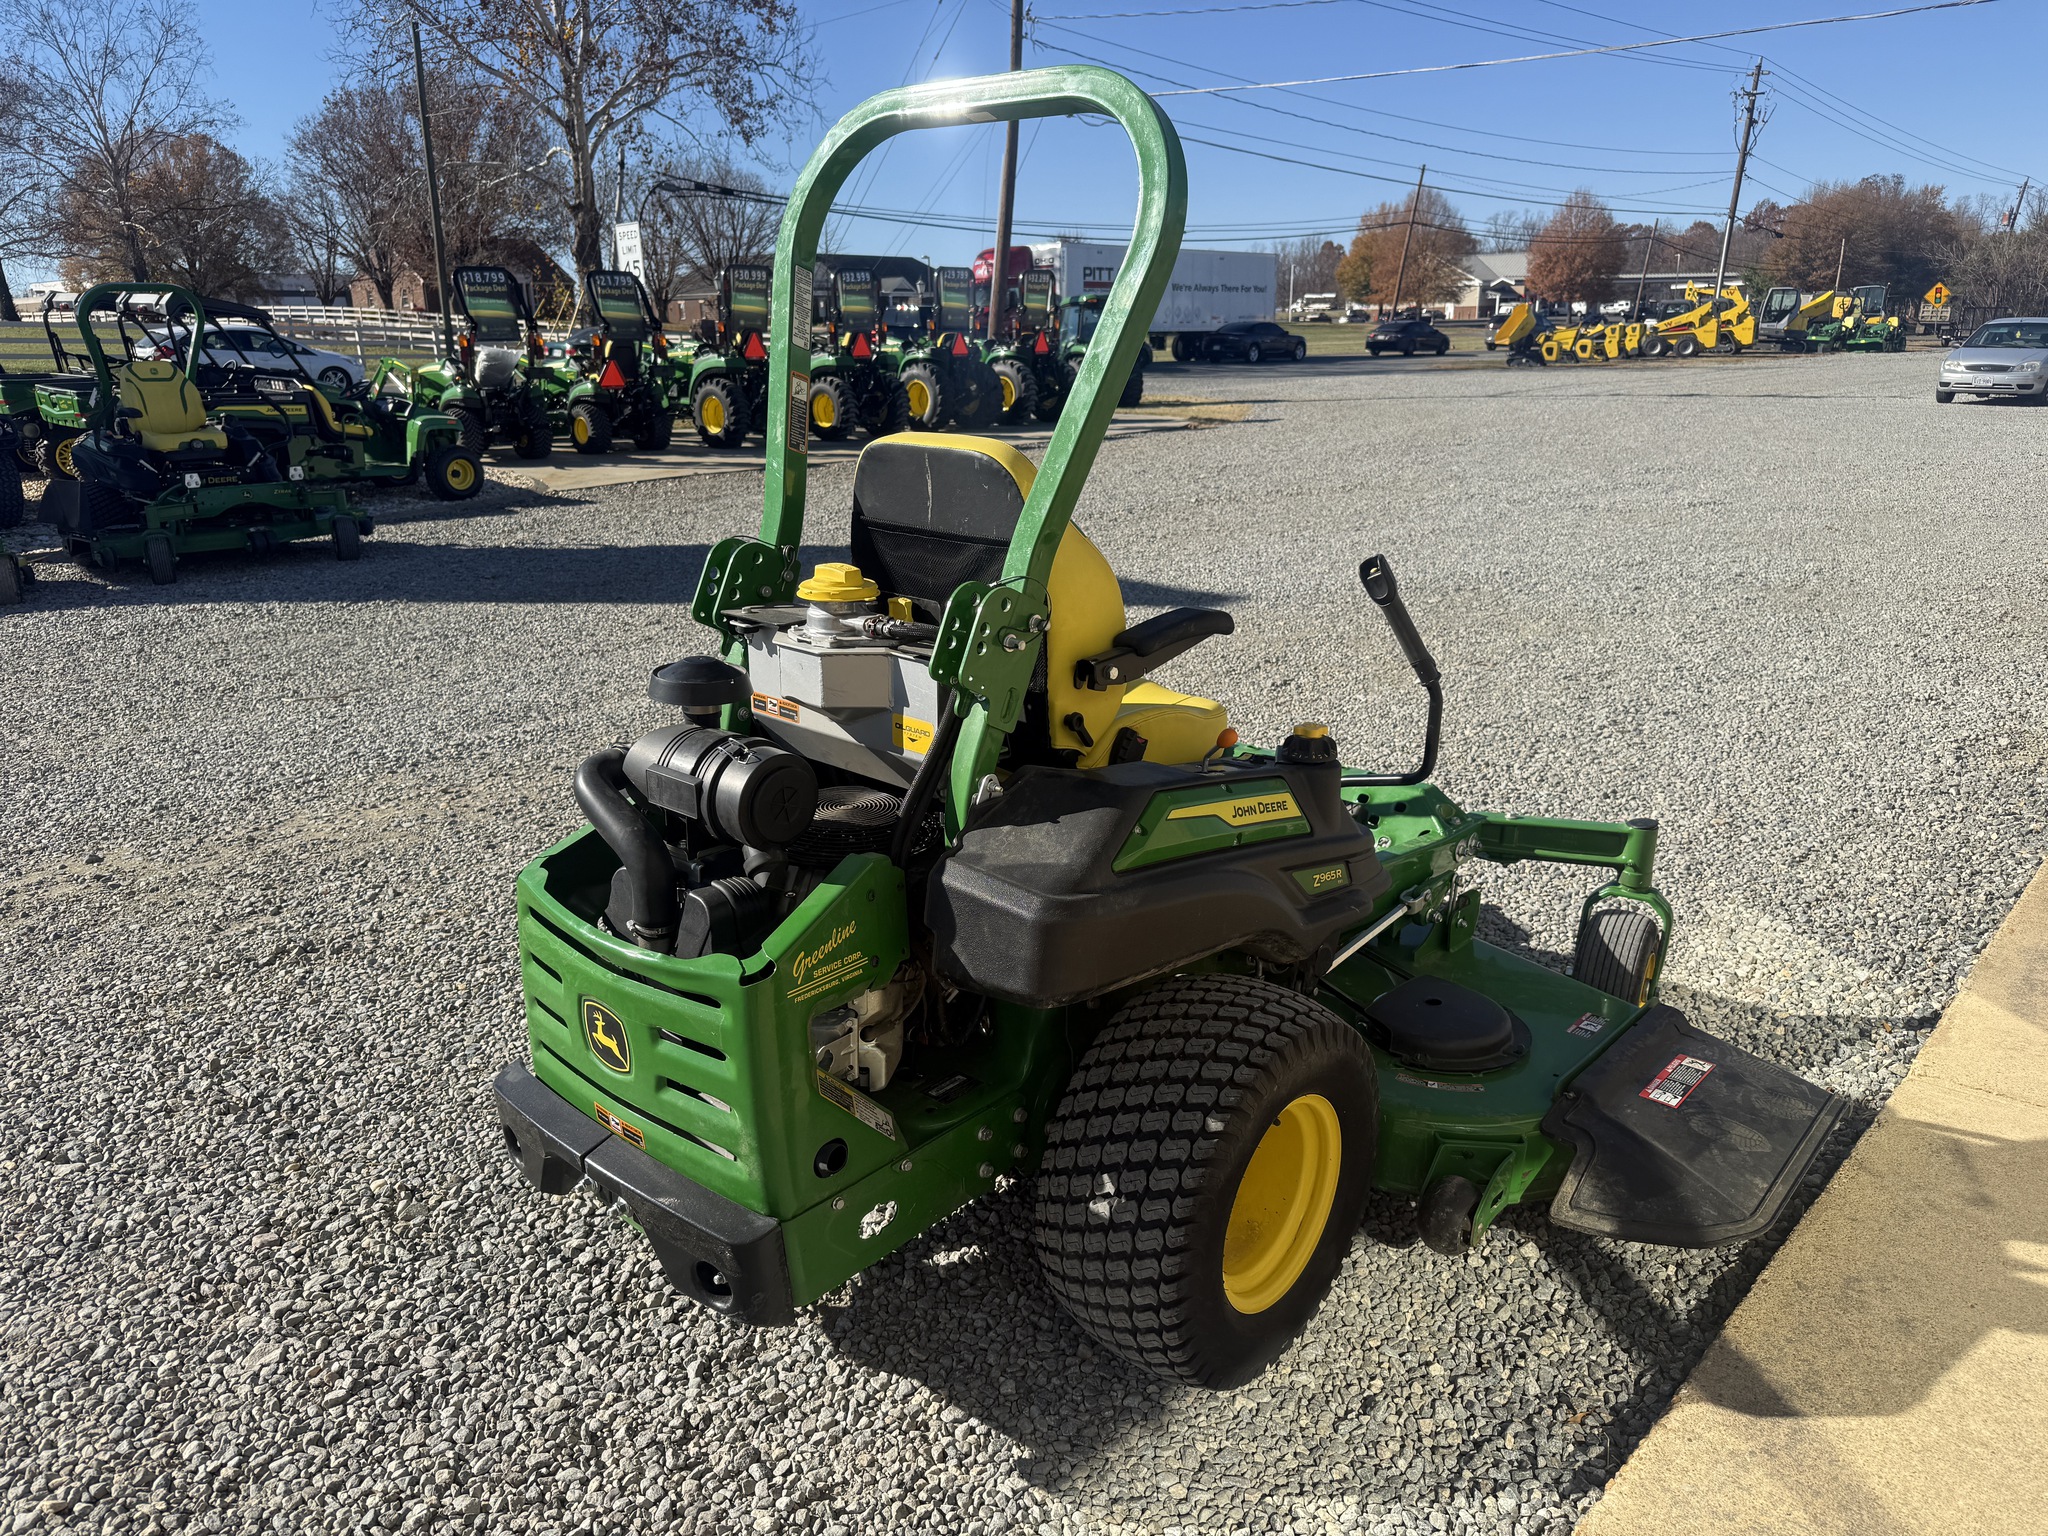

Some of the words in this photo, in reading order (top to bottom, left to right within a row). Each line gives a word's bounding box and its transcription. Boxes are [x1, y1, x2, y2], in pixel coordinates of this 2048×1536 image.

[618, 230, 638, 241] SPEED
[622, 245, 637, 255] LIMIT
[624, 260, 641, 279] 45
[1083, 266, 1114, 281] PITT
[465, 285, 492, 294] Package
[598, 287, 621, 297] Package
[1172, 282, 1192, 292] We're
[1193, 283, 1219, 295] Always
[1220, 283, 1239, 293] There
[1241, 284, 1252, 293] For
[1253, 285, 1267, 294] You!
[207, 475, 238, 484] DEERE
[1232, 805, 1257, 818] JOHN
[1258, 800, 1289, 814] DEERE
[1313, 869, 1342, 887] Z965R
[793, 920, 857, 985] Greenline
[813, 959, 842, 978] SERVICE
[843, 951, 863, 965] CORP.
[794, 979, 840, 1004] FREDERICKSBURG,
[841, 968, 863, 982] VIRGINIA
